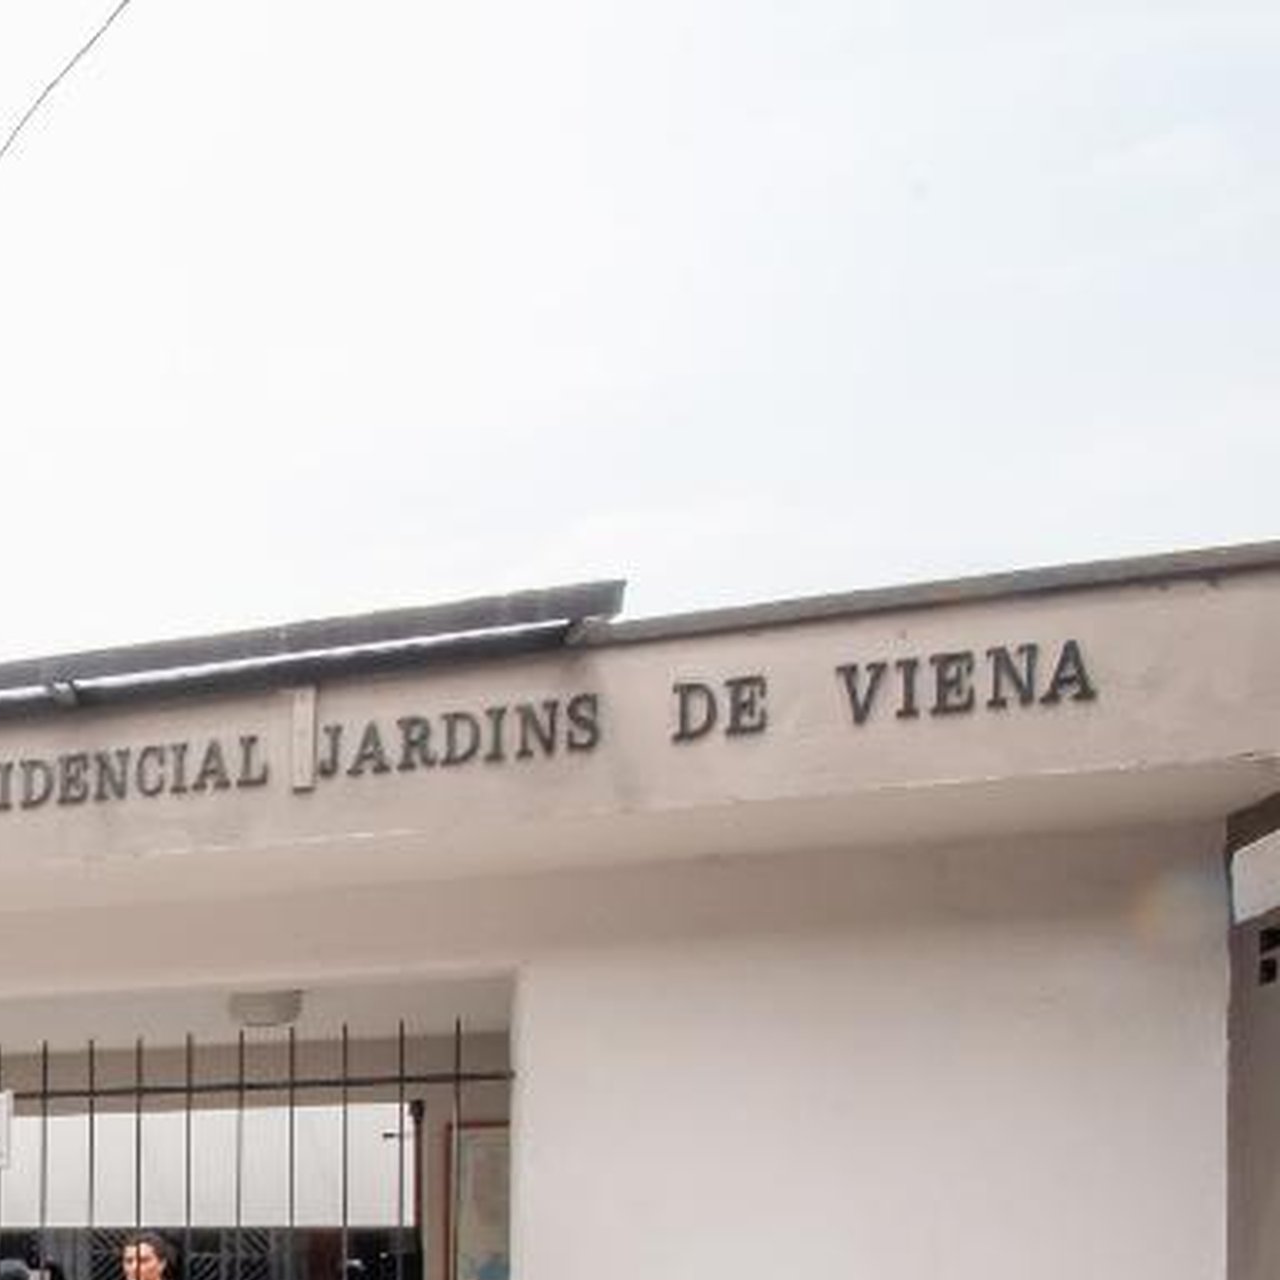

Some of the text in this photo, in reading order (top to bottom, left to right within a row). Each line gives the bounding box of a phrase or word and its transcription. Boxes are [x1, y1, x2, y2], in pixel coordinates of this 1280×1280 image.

[317, 691, 602, 779] JARDINS
[671, 676, 768, 743] DE
[837, 638, 1099, 726] VIENA
